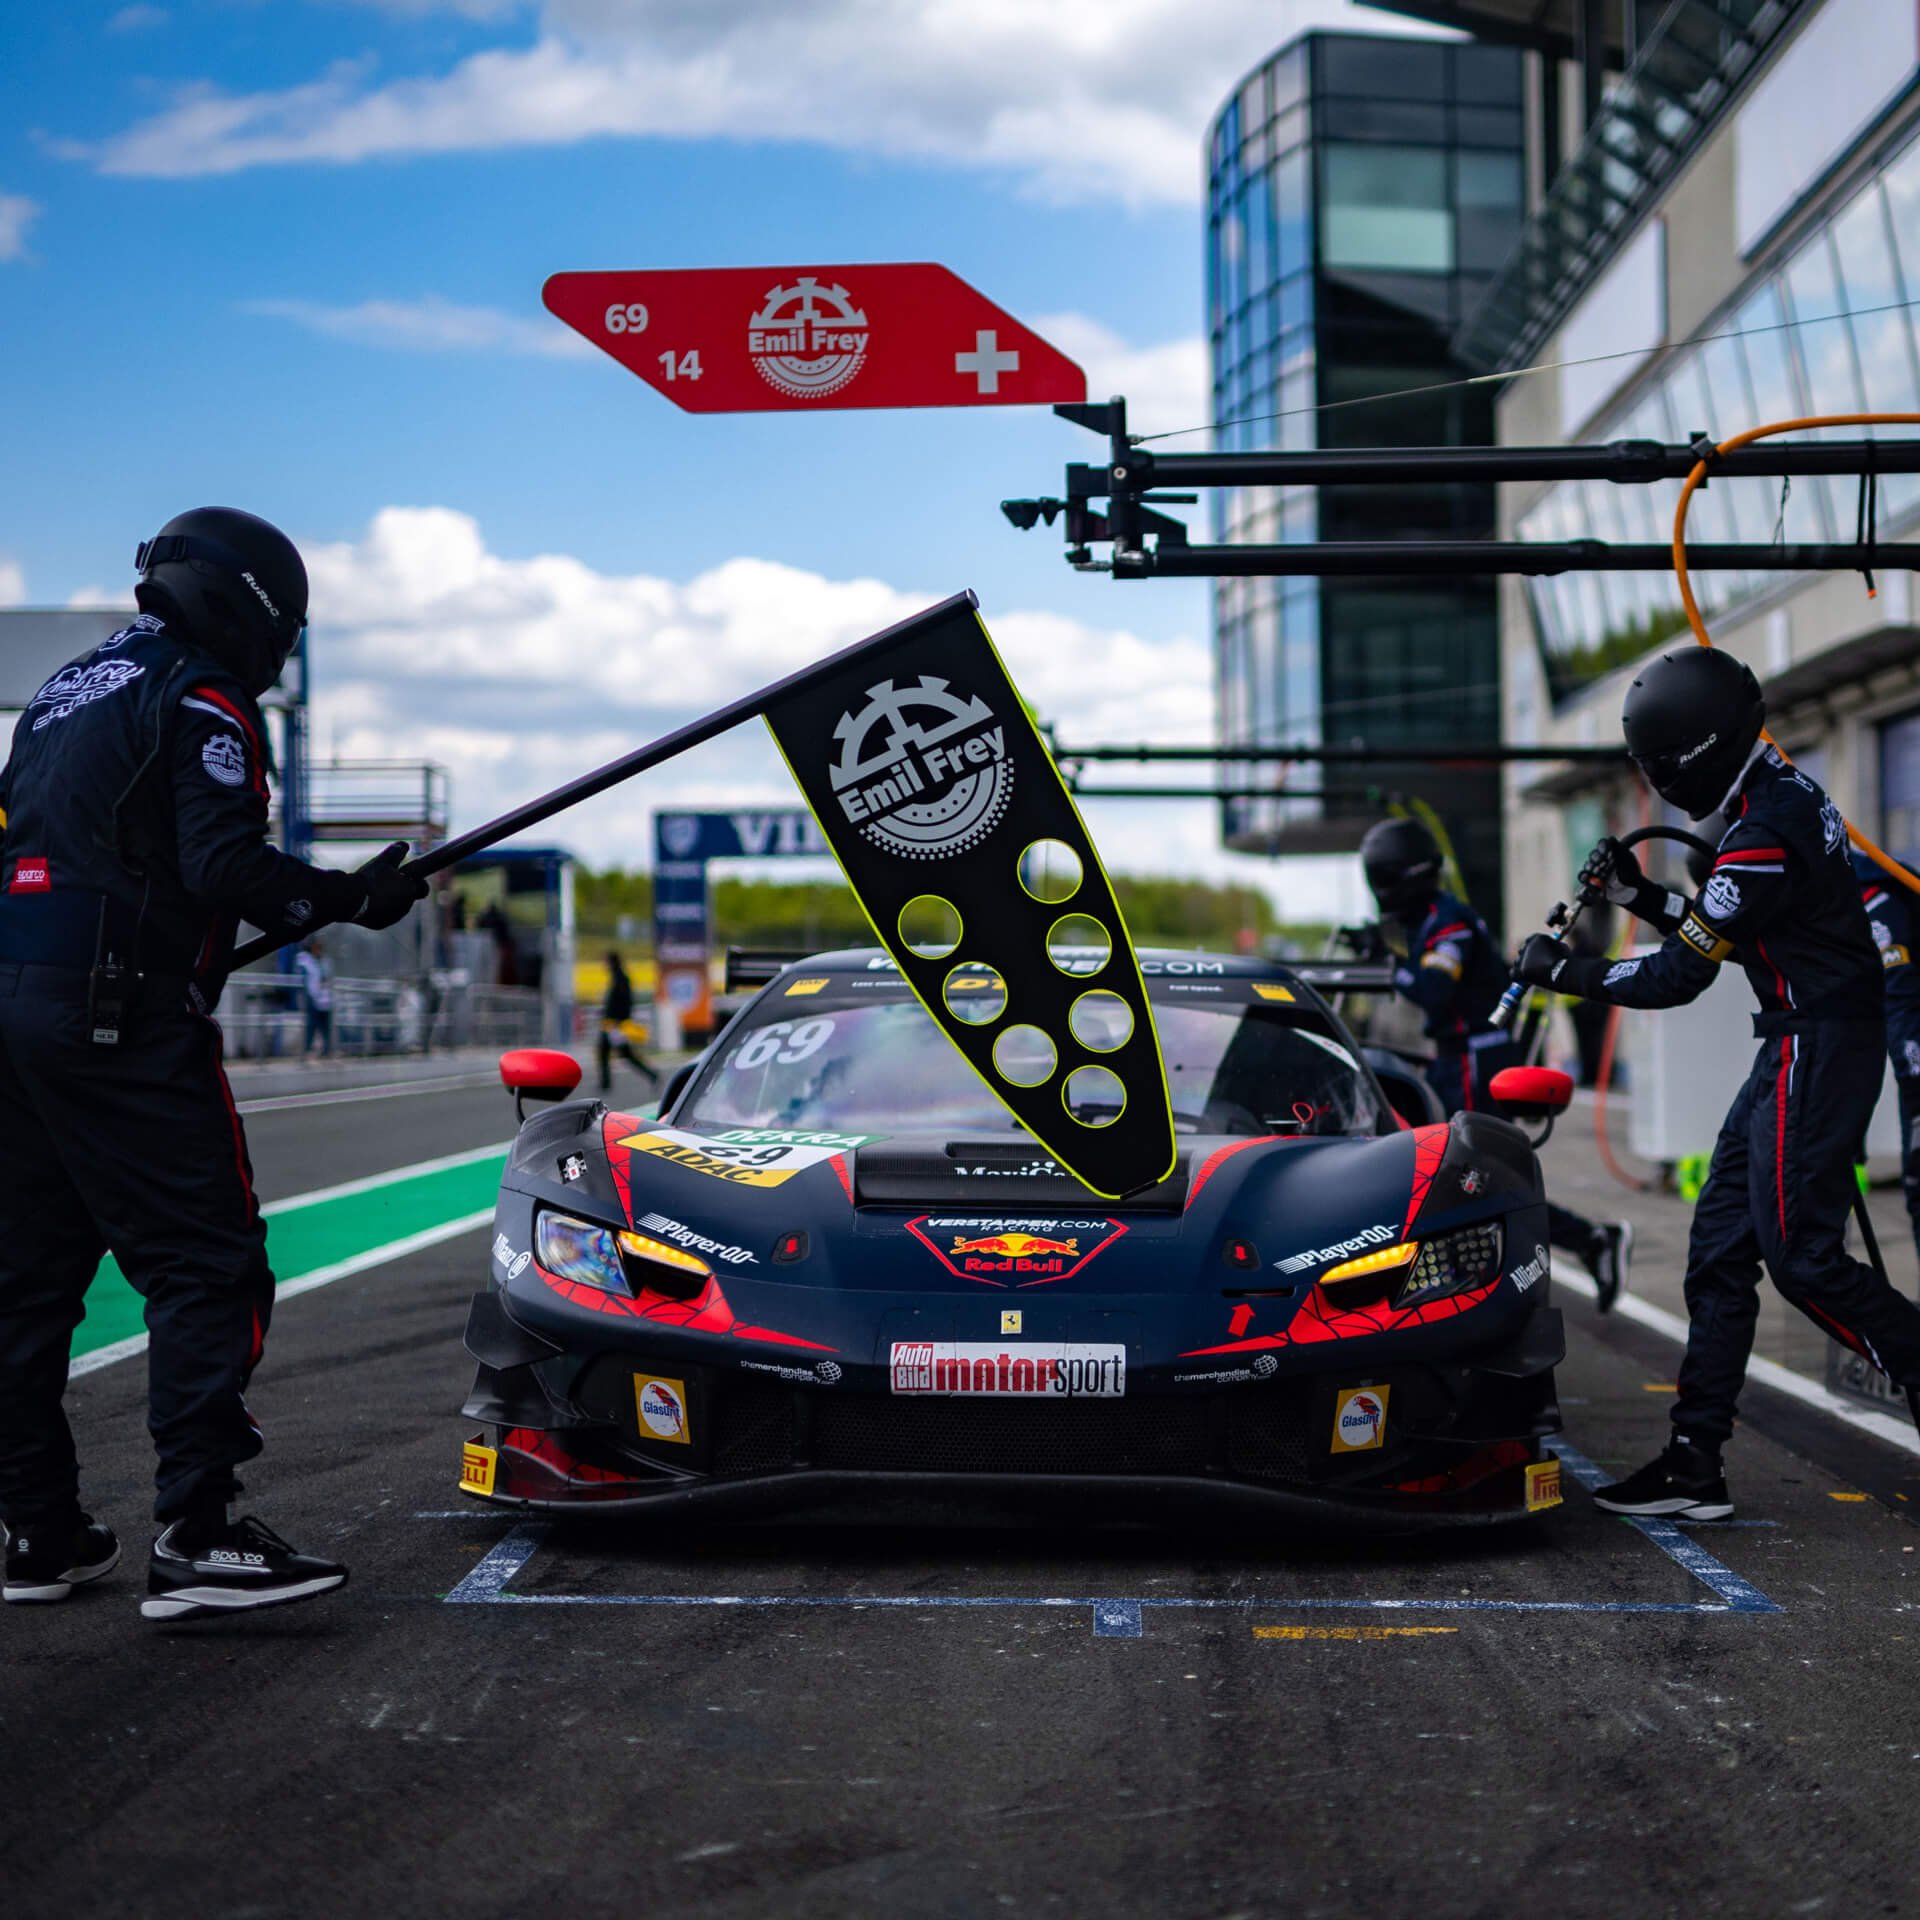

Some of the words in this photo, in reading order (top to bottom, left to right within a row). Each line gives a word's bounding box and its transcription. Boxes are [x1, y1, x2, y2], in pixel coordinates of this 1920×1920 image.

[604, 303, 648, 335] 69
[748, 328, 805, 353] Emil
[811, 330, 869, 355] Frey
[658, 350, 702, 382] 14
[202, 751, 227, 772] Emil
[837, 758, 925, 824] Emil
[925, 725, 1005, 784] Frey
[729, 815, 831, 856] VI
[1681, 917, 1718, 952] DTM
[949, 978, 1007, 991] DT
[734, 1019, 836, 1070] 69
[707, 1130, 868, 1149] DEKRA
[646, 1145, 763, 1182] ADAC
[699, 1146, 794, 1166] 69
[927, 1218, 1108, 1230] VERSTAPPEN.COM
[965, 1258, 1013, 1272] Red
[1016, 1258, 1063, 1273] Bull
[1508, 1260, 1543, 1294] Allianz
[894, 1344, 932, 1366] Auto
[896, 1366, 930, 1389] Bild
[208, 1550, 265, 1565] spaco
